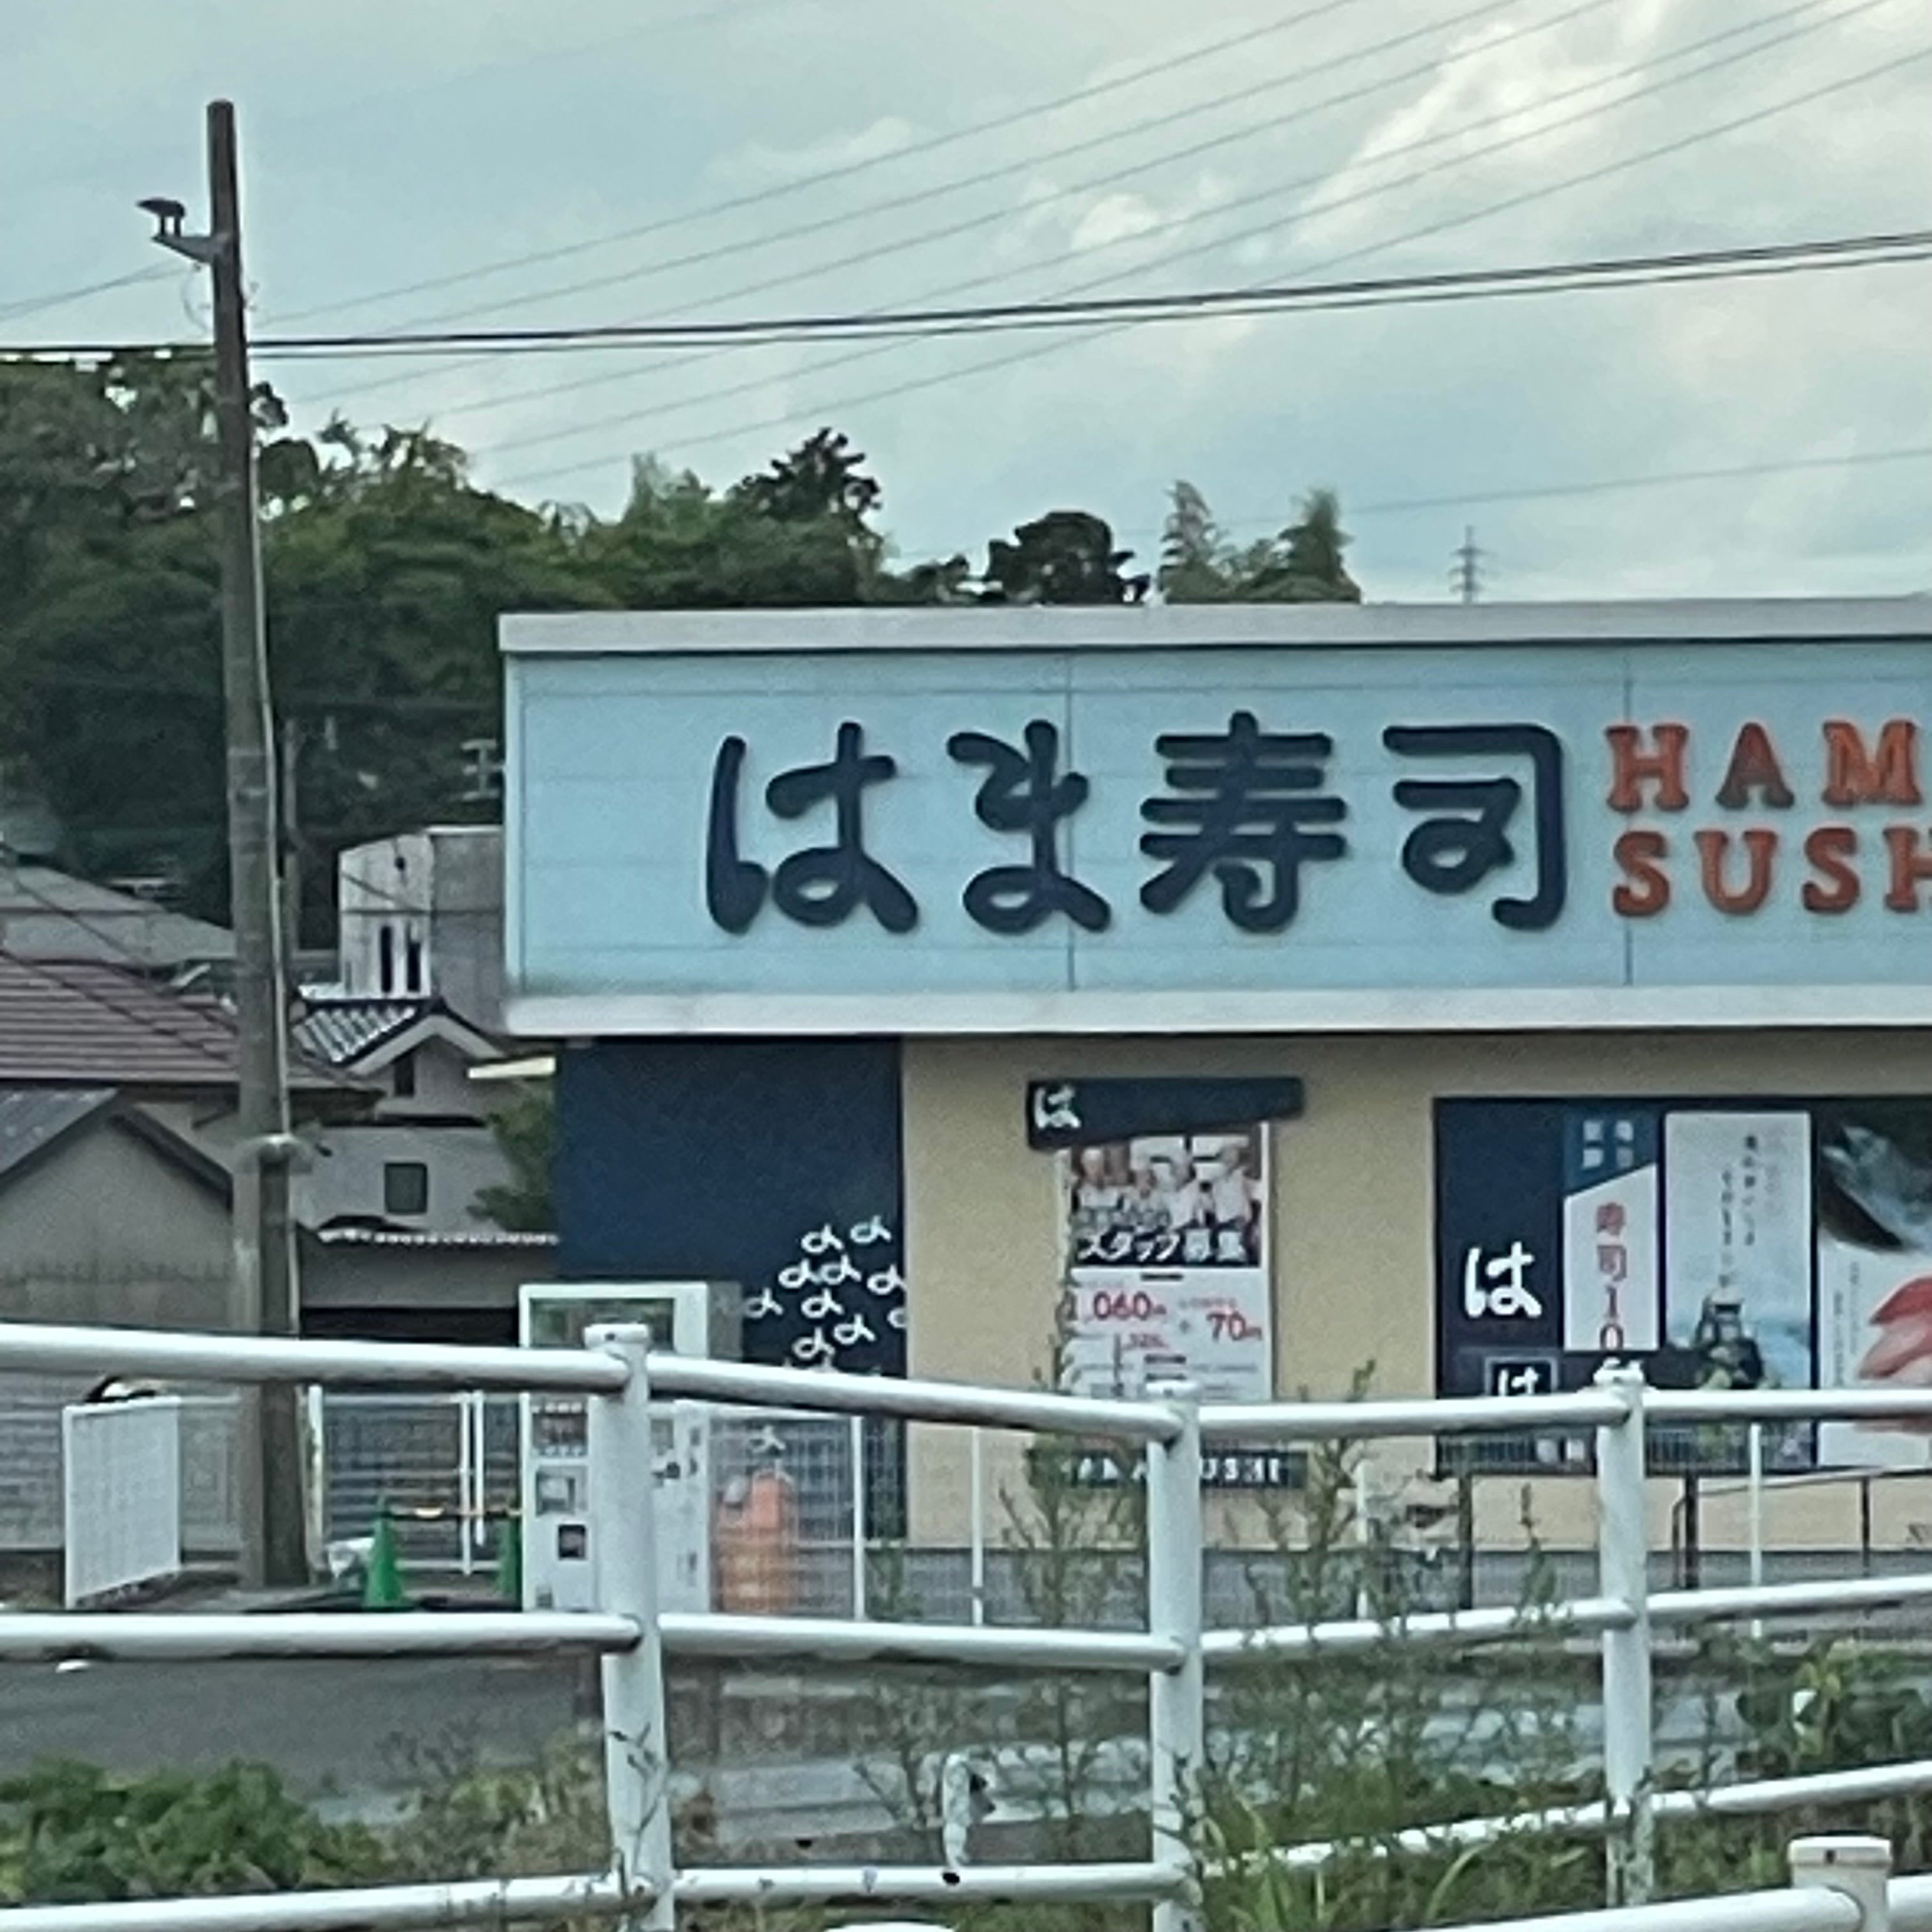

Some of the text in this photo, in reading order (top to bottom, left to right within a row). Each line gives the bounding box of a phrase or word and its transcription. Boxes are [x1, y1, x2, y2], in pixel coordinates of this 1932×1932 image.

[1604, 720, 1921, 812] HAM
[707, 710, 1566, 933] はま寿司
[1034, 1085, 1082, 1129] は
[1464, 1241, 1542, 1318] は
